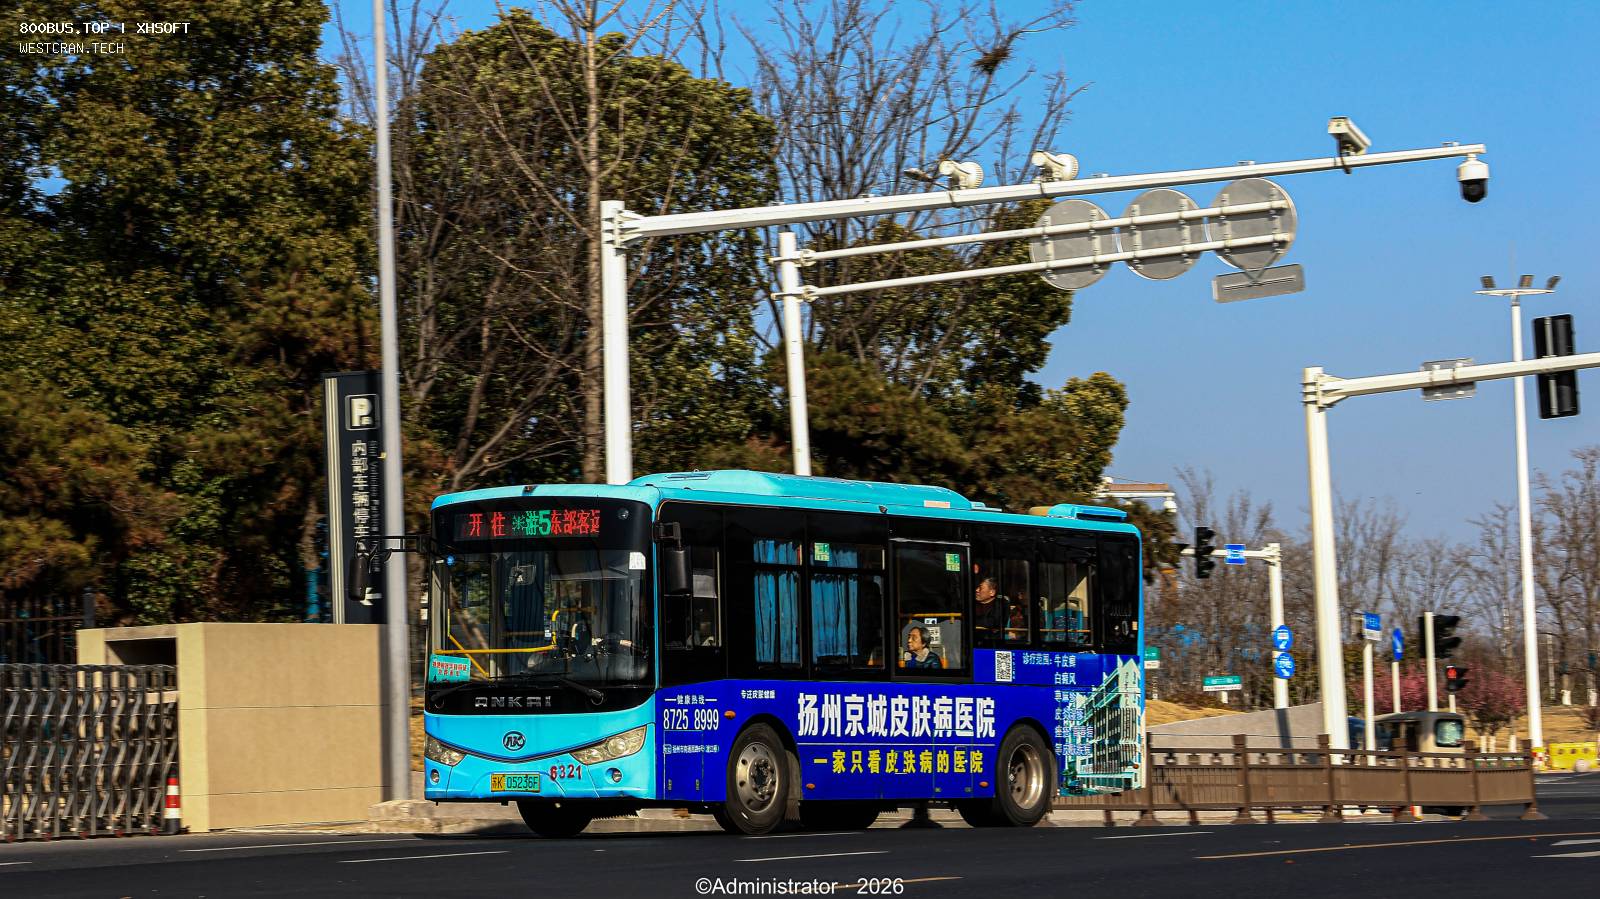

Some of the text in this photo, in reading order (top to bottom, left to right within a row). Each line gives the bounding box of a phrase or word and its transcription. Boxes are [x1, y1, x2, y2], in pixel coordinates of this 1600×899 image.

[474, 696, 552, 708] ANKAI
[663, 708, 720, 731] 8725 8999
[797, 692, 995, 738] 扬州京城皮肤病医院
[549, 764, 583, 782] 6321
[813, 749, 984, 774] 一家只看皮肤病的医院
